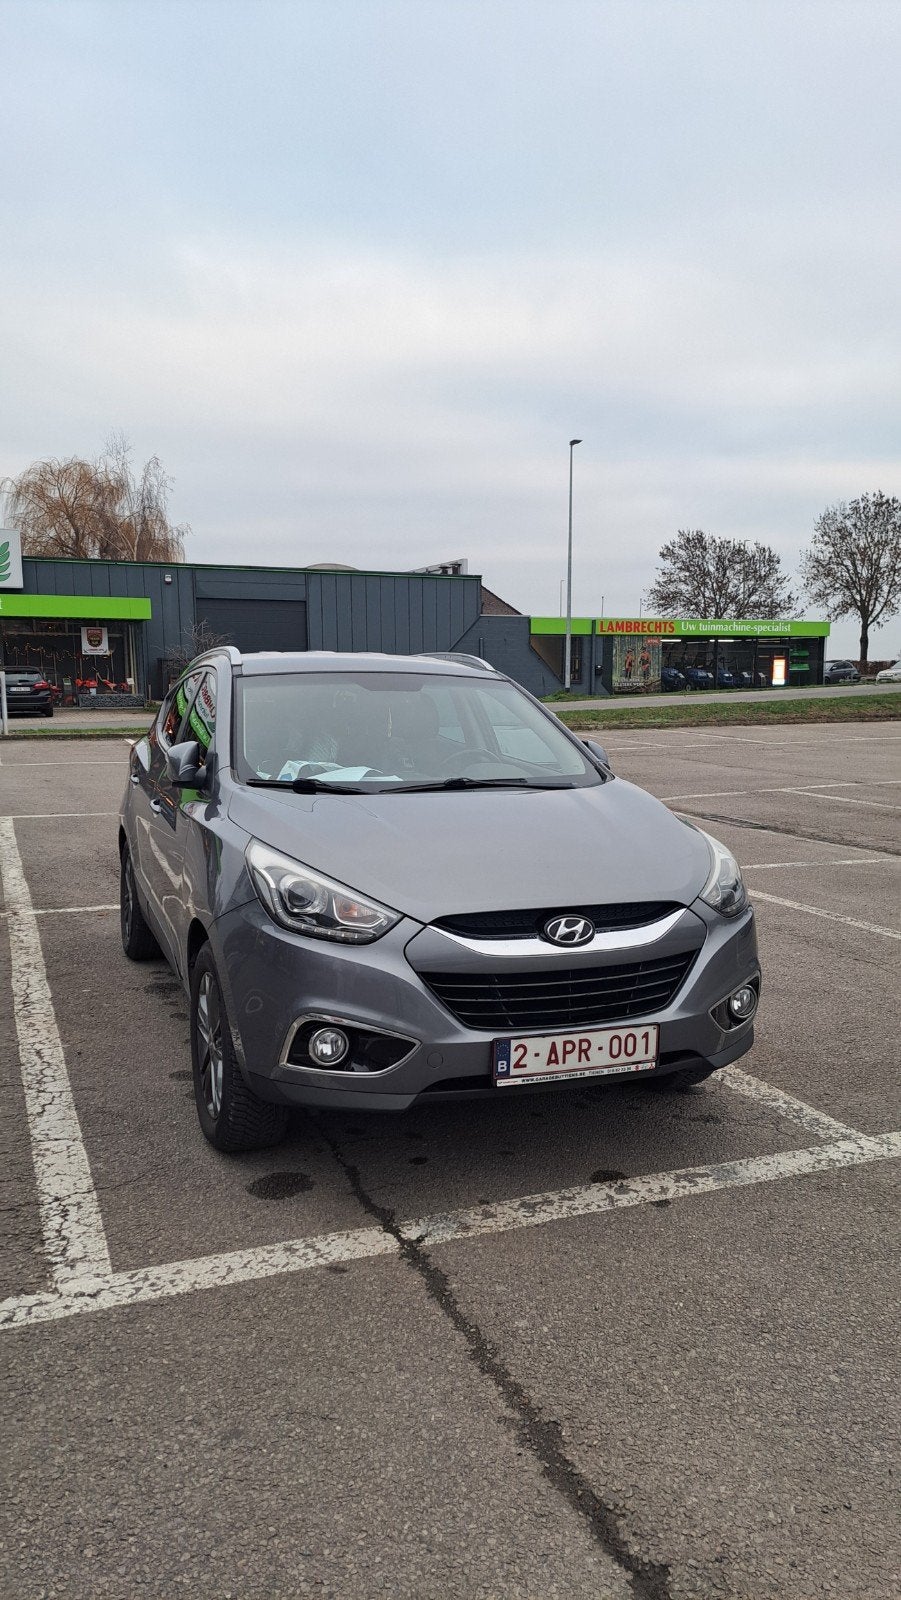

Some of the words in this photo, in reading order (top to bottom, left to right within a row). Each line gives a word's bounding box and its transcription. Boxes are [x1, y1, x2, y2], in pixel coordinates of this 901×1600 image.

[600, 620, 675, 633] LAMBRECHTS
[682, 622, 696, 631] Uw
[699, 621, 791, 634] tuinmachine-specialist
[513, 1031, 649, 1069] 2-APR-001
[497, 1061, 507, 1072] B
